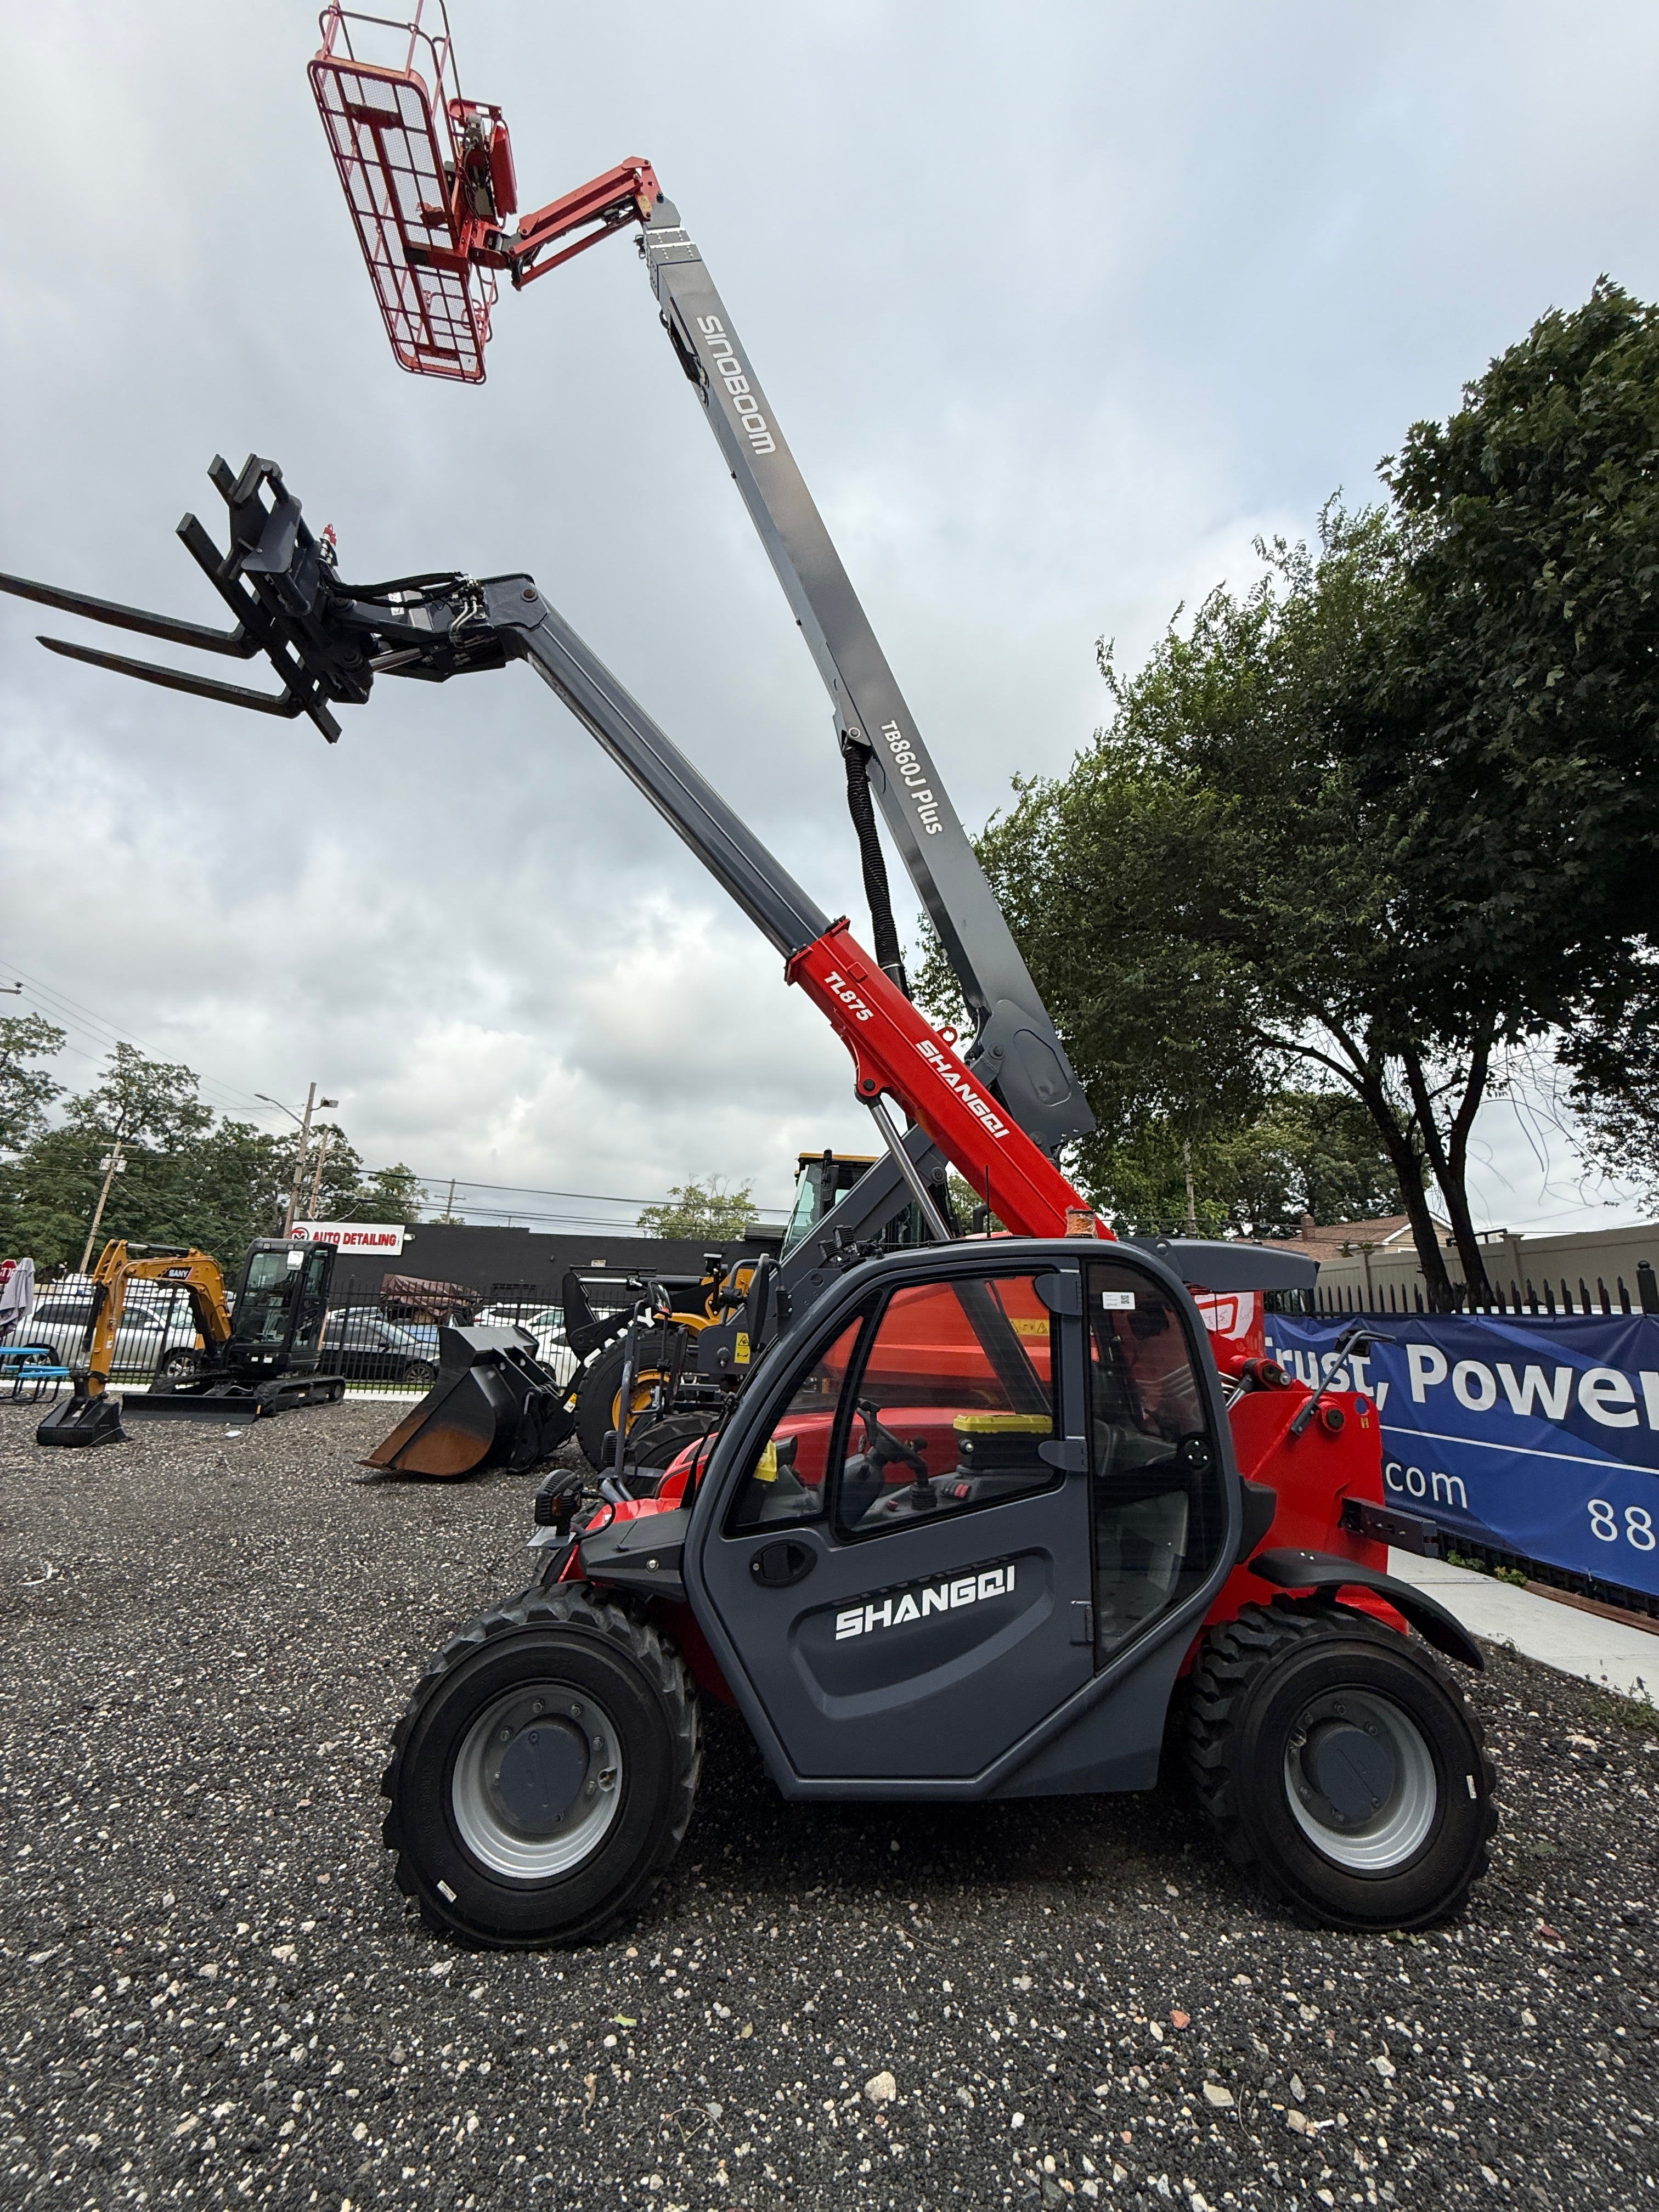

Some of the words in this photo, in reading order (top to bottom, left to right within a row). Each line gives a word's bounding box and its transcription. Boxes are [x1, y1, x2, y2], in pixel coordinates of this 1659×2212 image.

[881, 720, 927, 787] TB860J
[911, 789, 943, 834] Plus
[824, 970, 874, 1021] TL875
[915, 1040, 1010, 1138] SHANGQI
[313, 1231, 341, 1245] AUTO
[342, 1233, 397, 1246] DETAILING
[1265, 1337, 1389, 1411] rust,
[835, 1565, 1015, 1641] SHANGQI
